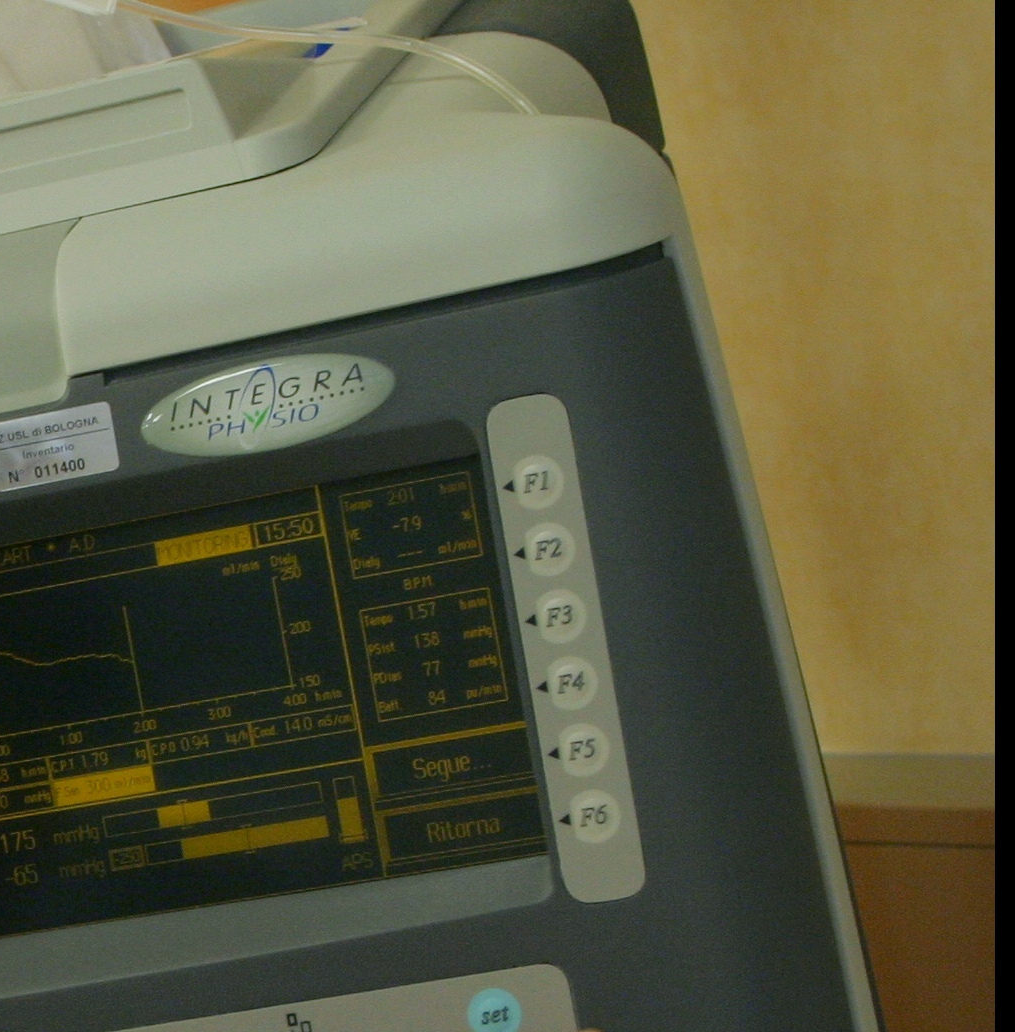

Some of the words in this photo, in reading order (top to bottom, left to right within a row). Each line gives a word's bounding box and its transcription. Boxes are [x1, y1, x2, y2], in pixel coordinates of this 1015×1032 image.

[170, 362, 365, 422] INTEGRA
[7, 430, 29, 442] USL
[32, 427, 42, 437] di
[45, 416, 99, 435] BOLOGNA
[208, 403, 321, 441] PHYSIO
[22, 443, 75, 459] Inventario
[34, 458, 86, 478] 011400
[523, 470, 551, 494] F1
[535, 538, 563, 561] F2
[289, 620, 312, 635] 200
[546, 605, 574, 628] F3
[415, 631, 440, 648] 138
[422, 660, 441, 676] 77
[300, 674, 321, 688] 150
[557, 672, 585, 694] F4
[428, 690, 447, 705] 84
[568, 739, 597, 761] F5
[580, 805, 608, 828] F6
[0, 829, 36, 853] 175
[54, 824, 100, 846] mmHg
[427, 817, 503, 844] Ritorna
[6, 864, 39, 886] -65
[58, 860, 106, 881] mmHg
[481, 1006, 509, 1025] set
